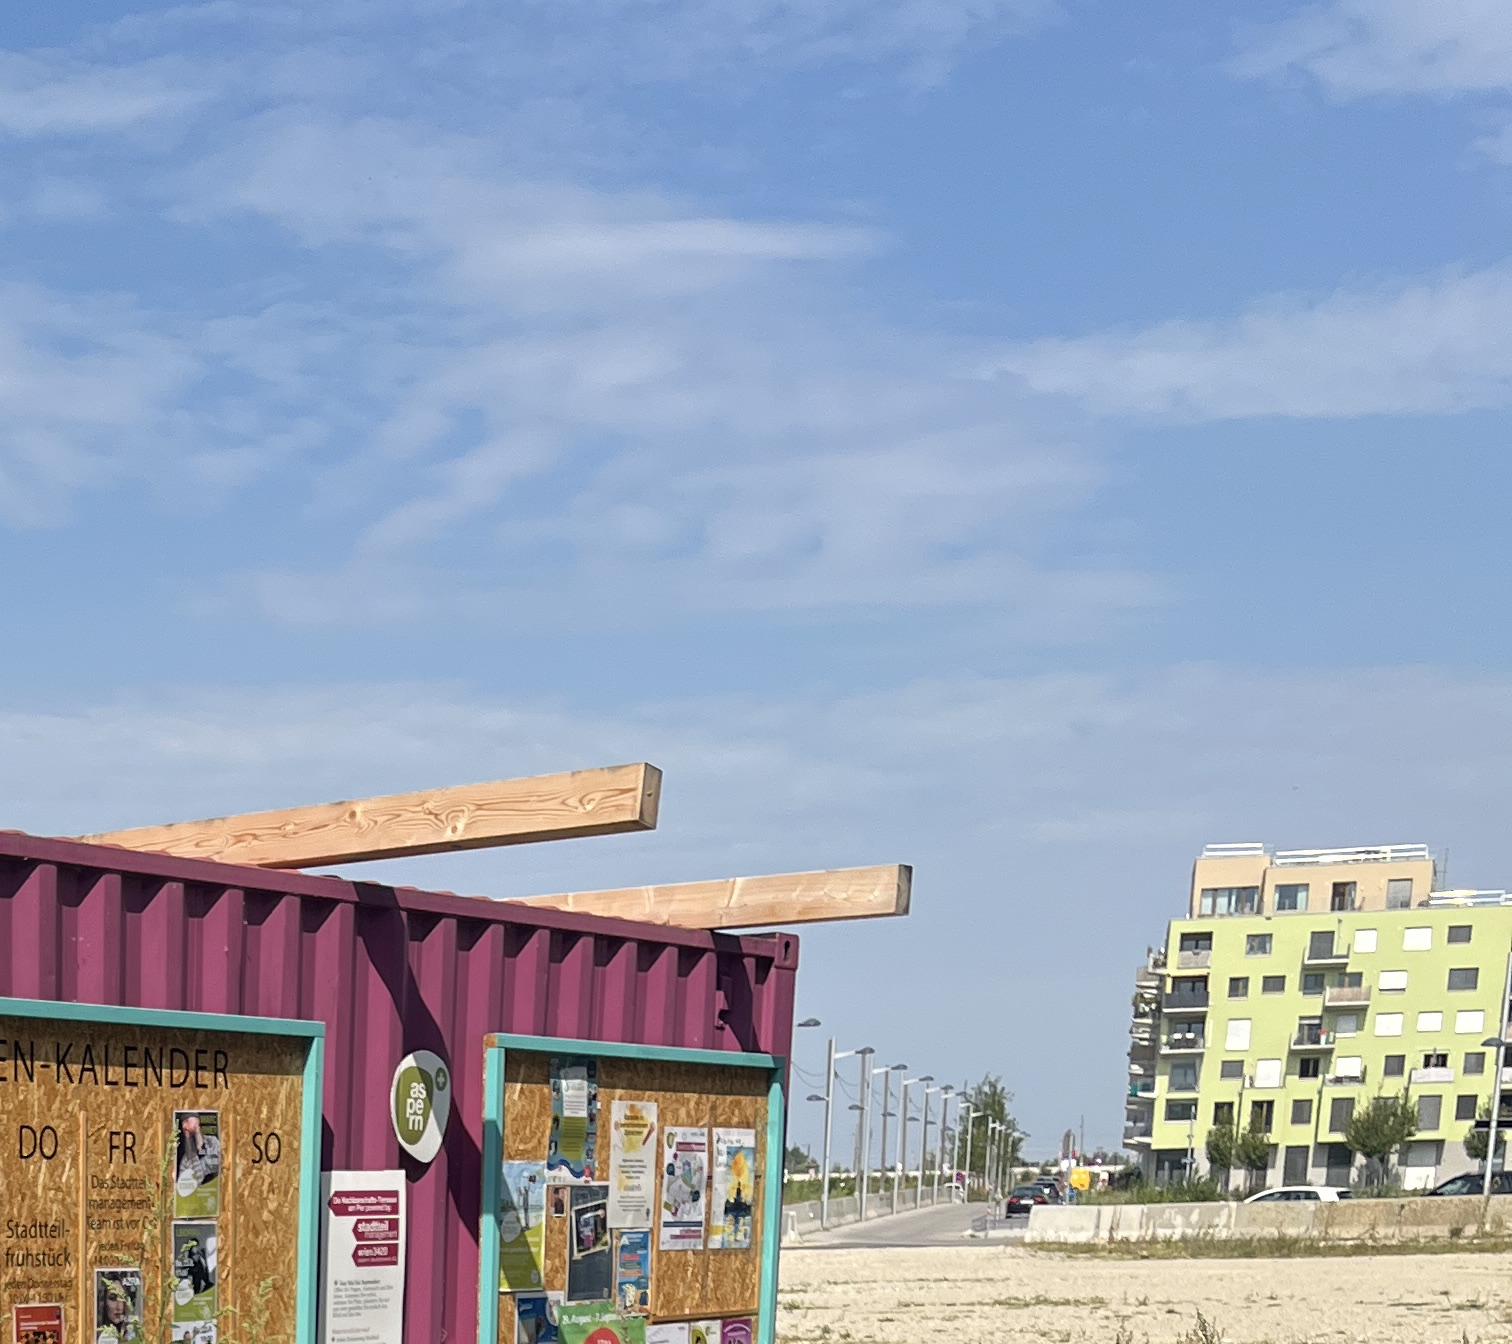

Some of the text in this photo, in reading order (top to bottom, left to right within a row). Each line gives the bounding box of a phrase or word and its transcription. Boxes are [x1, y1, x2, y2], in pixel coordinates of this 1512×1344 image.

[410, 1082, 427, 1099] as
[406, 1098, 424, 1119] pe
[19, 1125, 58, 1161] DO
[108, 1131, 137, 1165] FR
[251, 1131, 282, 1164] SO
[6, 1218, 70, 1240] Stadtteil-
